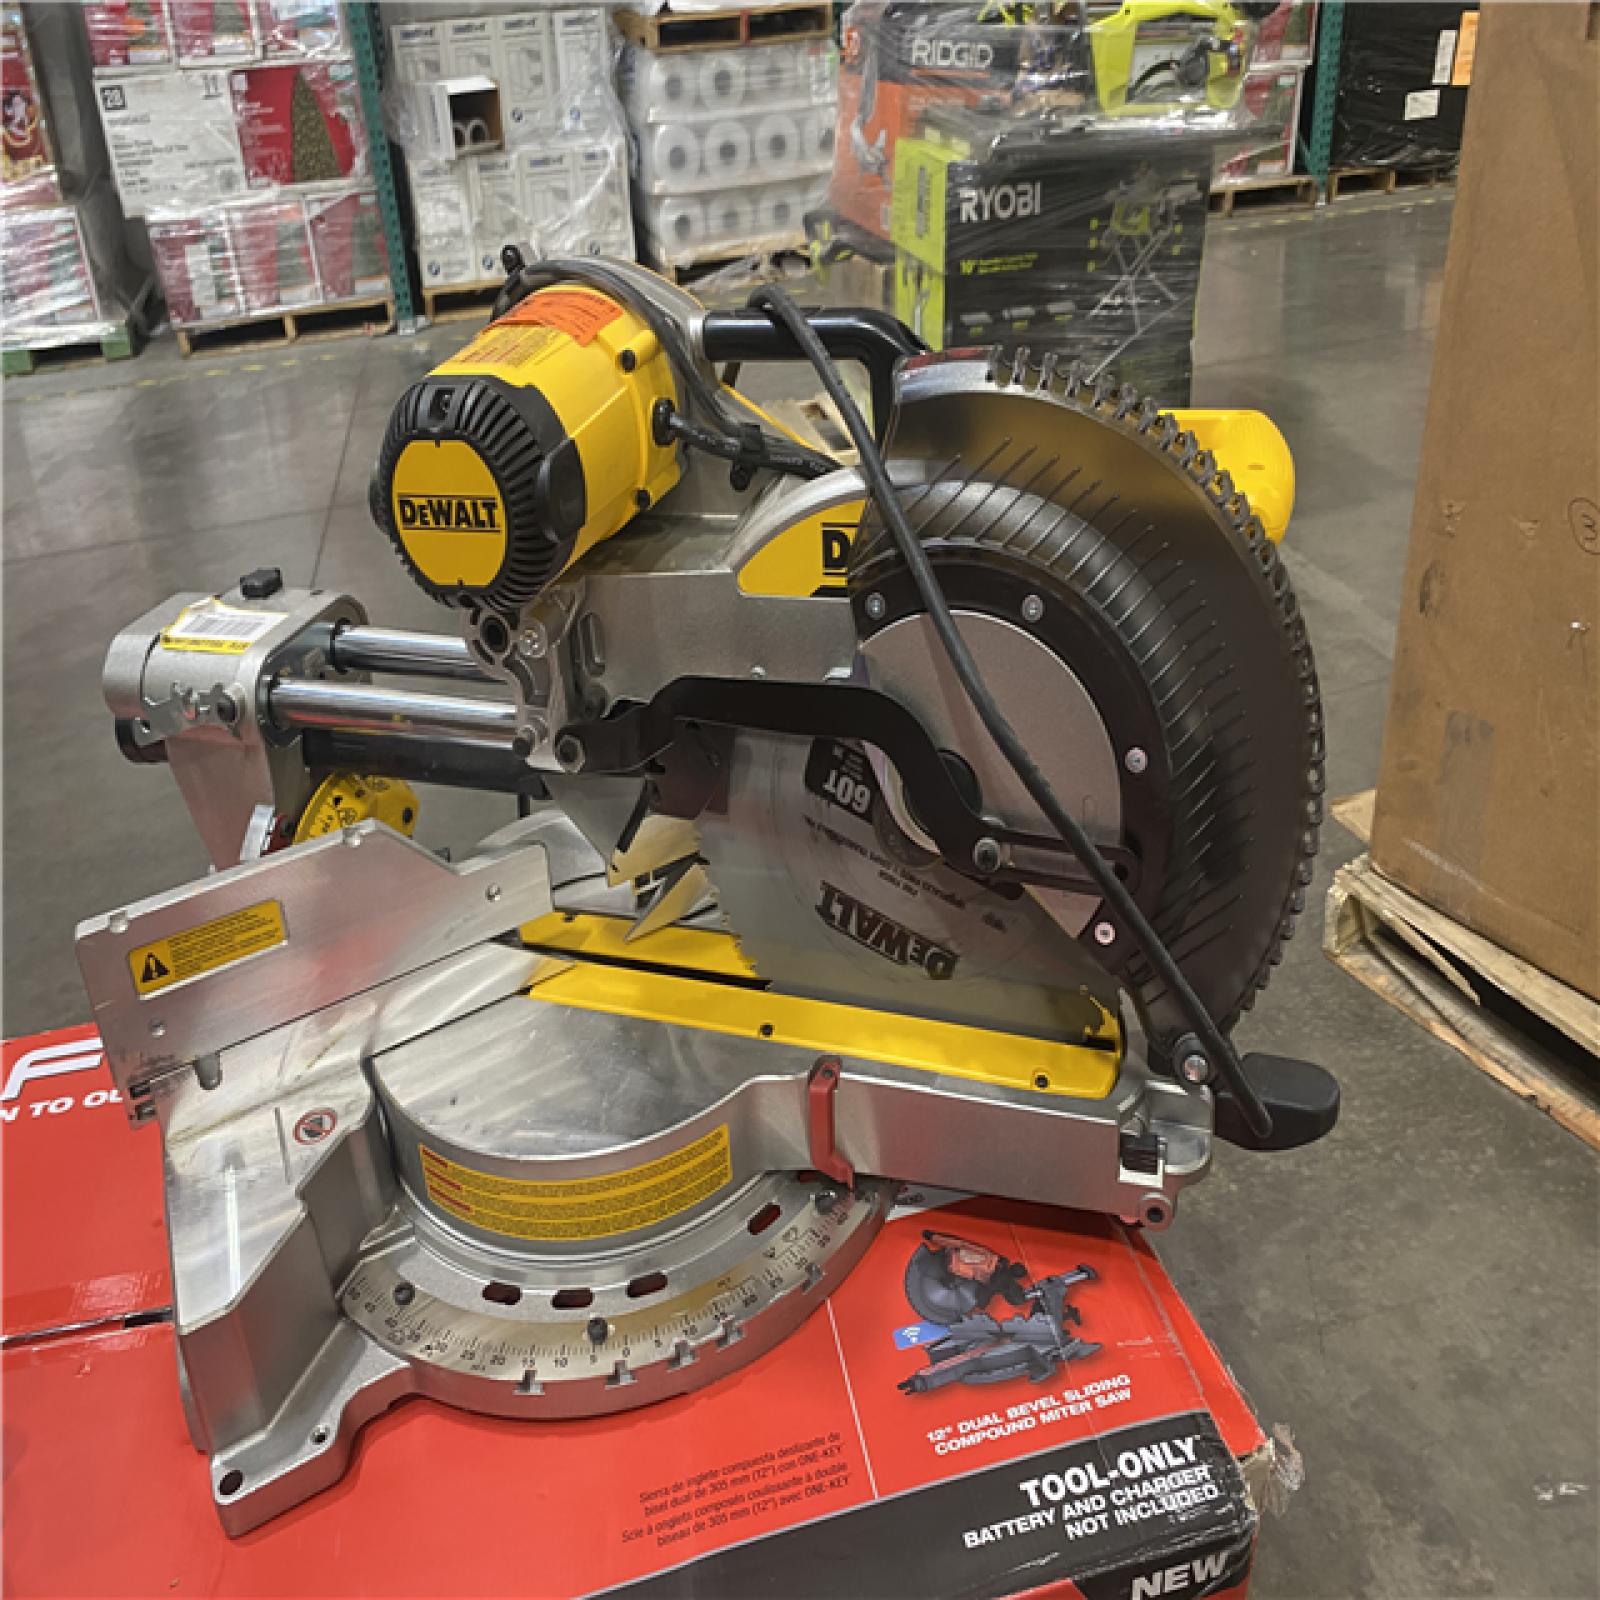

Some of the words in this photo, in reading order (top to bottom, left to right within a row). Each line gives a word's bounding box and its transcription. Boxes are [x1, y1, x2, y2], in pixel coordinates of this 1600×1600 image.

[911, 38, 993, 68] RIDGID
[959, 181, 1041, 223] RYOBI
[29, 1096, 75, 1117] TO
[934, 1415, 1036, 1456] COMPOUND
[1040, 1398, 1093, 1425] MITER
[1095, 1388, 1132, 1409] SAW
[957, 1411, 1003, 1434] DUAL
[1007, 1395, 1061, 1420] BEVEL
[1064, 1373, 1131, 1404] SLIDING
[1020, 1437, 1198, 1508] TOOL-ONLY
[963, 1508, 1057, 1549] BATTERY
[1062, 1494, 1106, 1521] AND
[1109, 1463, 1211, 1507] CHARGER
[1064, 1514, 1109, 1541] NOT
[1114, 1484, 1219, 1526] INCLUDED
[1131, 1551, 1230, 1599] NEW
